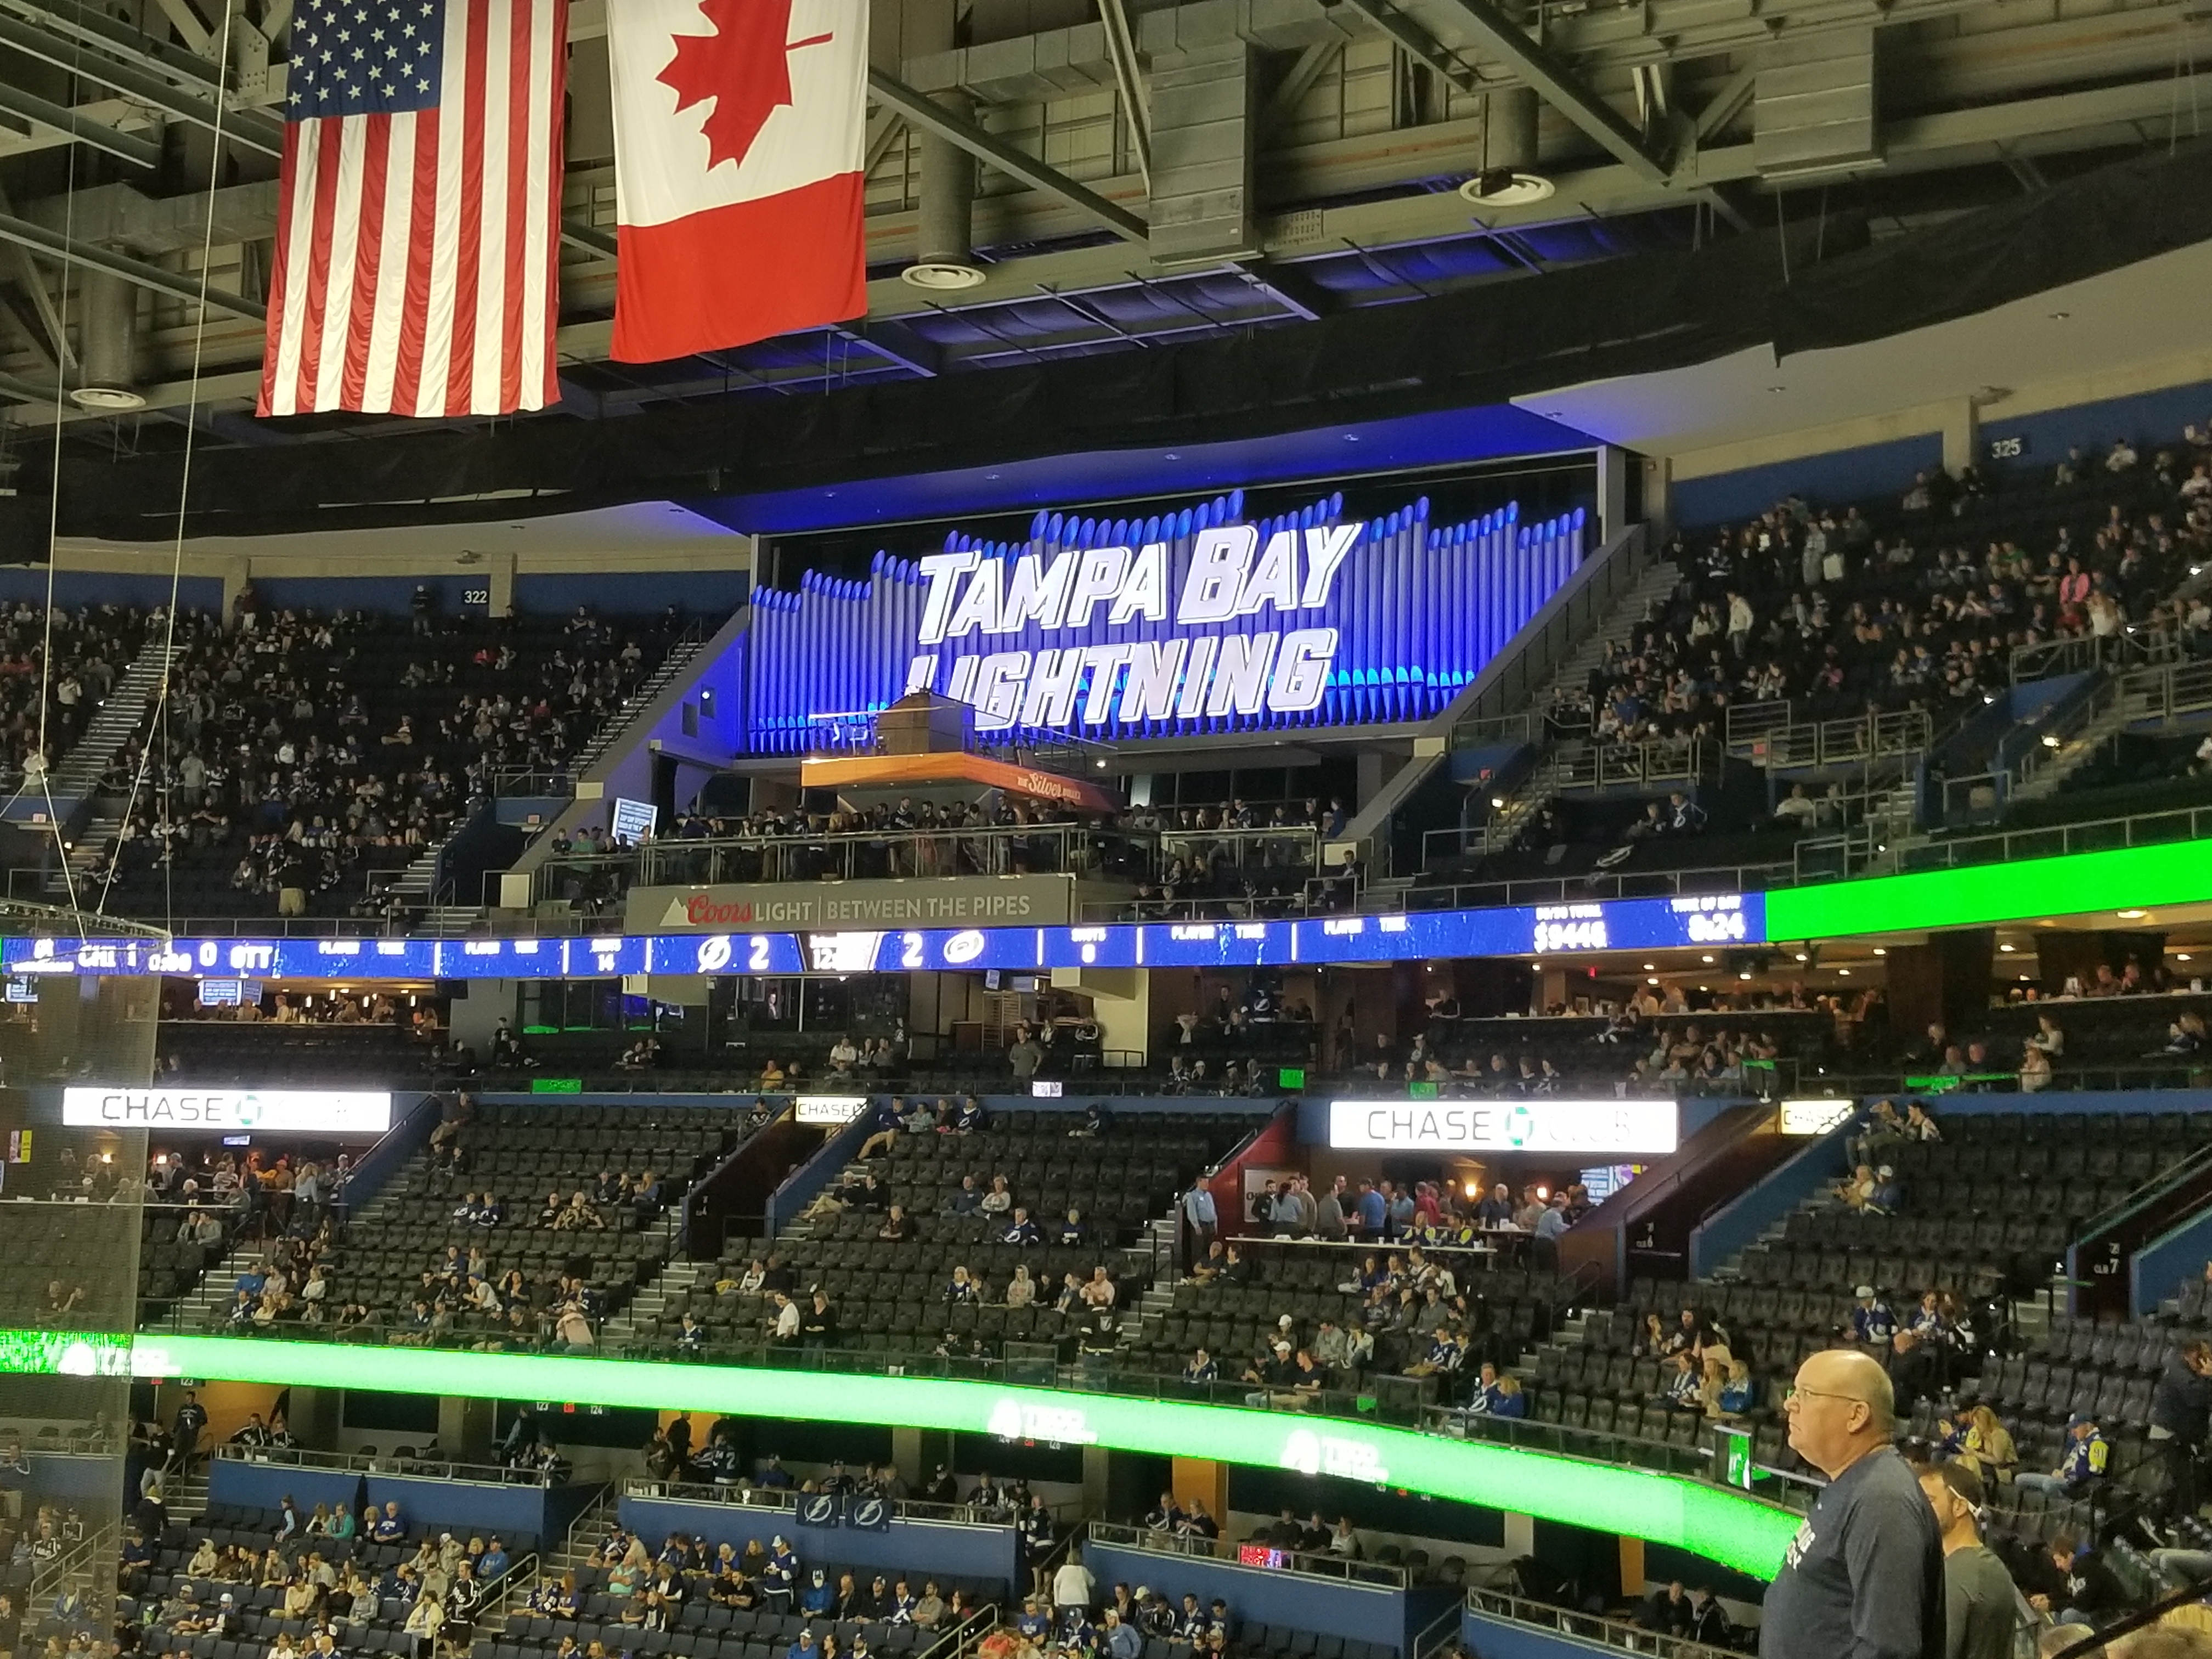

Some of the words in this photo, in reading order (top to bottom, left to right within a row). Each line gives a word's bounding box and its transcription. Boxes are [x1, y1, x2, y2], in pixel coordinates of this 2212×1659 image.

[1992, 438, 2021, 459] 325
[465, 590, 487, 603] 322
[918, 541, 1166, 645] TAMPA
[1177, 523, 1364, 625] BAY
[688, 894, 753, 924] Coors
[755, 902, 812, 922] LIGHT
[827, 899, 921, 921] BETWEEN
[928, 898, 967, 917] THE
[974, 895, 1031, 916] PIPES
[749, 936, 769, 970] 2
[901, 933, 924, 967] 2
[101, 1096, 223, 1121] CHASE
[798, 1103, 850, 1117] CHASE
[1367, 1110, 1491, 1141] CHASE
